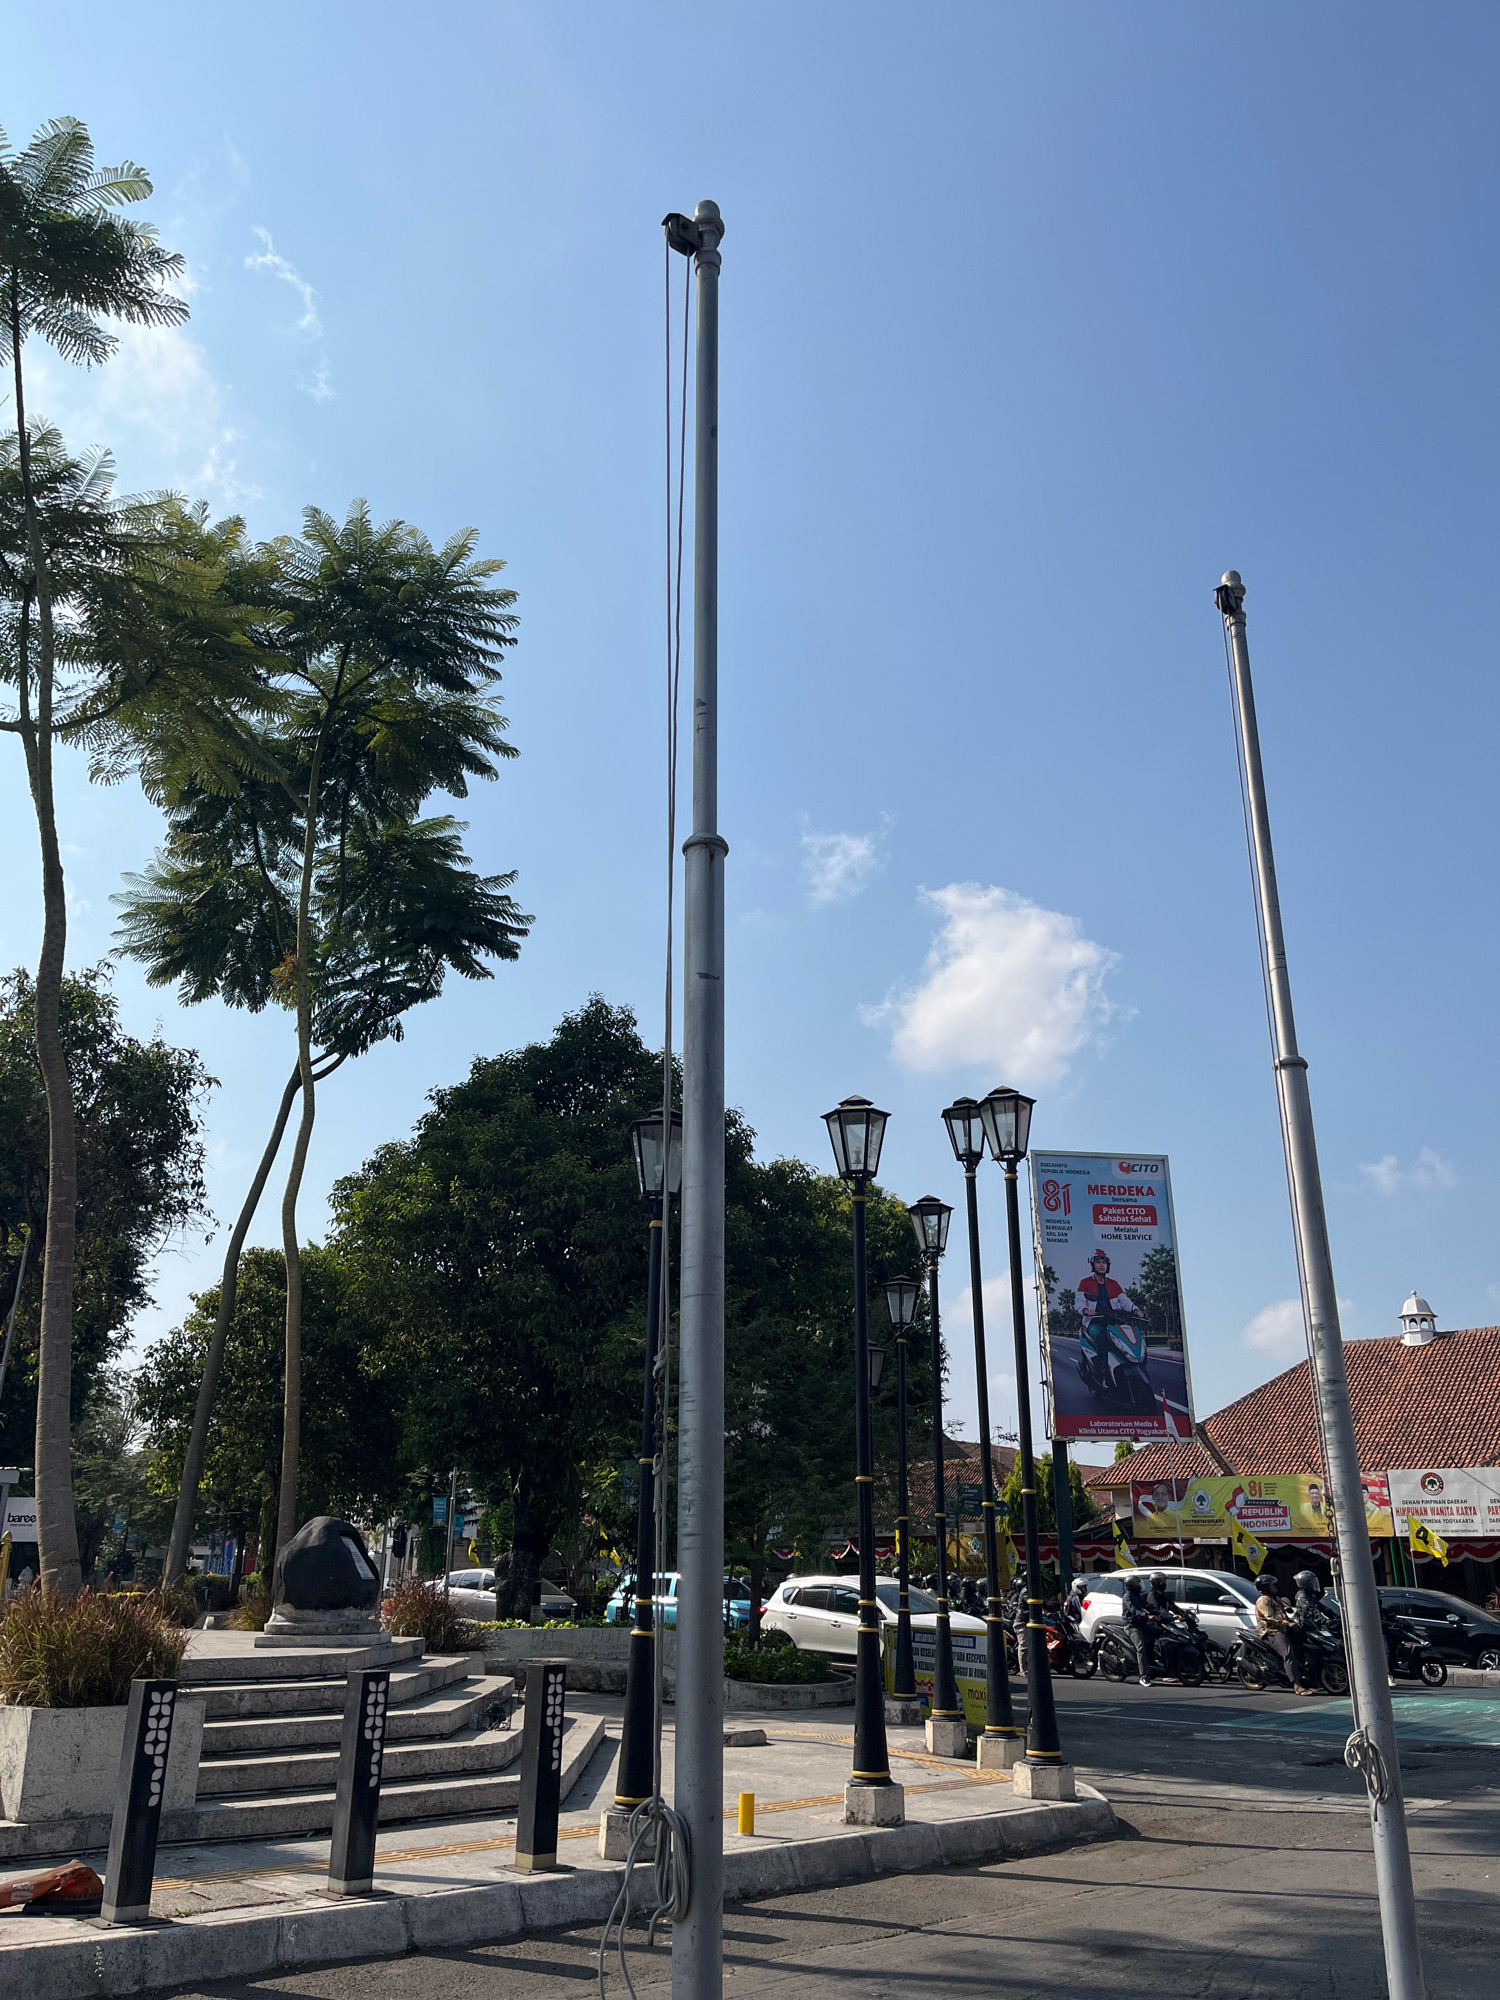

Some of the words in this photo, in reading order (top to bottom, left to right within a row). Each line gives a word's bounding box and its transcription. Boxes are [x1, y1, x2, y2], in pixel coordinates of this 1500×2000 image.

[1131, 1163, 1159, 1173] CITO
[1087, 1184, 1156, 1197] MERDEKA
[1042, 1179, 1072, 1217] 81
[1102, 1206, 1125, 1215] Paket
[1126, 1207, 1146, 1215] CITO
[1098, 1214, 1129, 1222] Sahabat
[1130, 1215, 1152, 1223] Sehat
[1100, 1233, 1123, 1241] HOME
[1133, 1420, 1152, 1428] Medis
[1247, 1479, 1262, 1498] 81
[1241, 1507, 1284, 1517] REPUBLIK
[1395, 1506, 1428, 1517] HIMPUNAN
[1429, 1506, 1455, 1517] WANITA
[1455, 1505, 1478, 1516] KARYA
[7, 1512, 37, 1523] baree
[1241, 1518, 1288, 1529] INDONESIA
